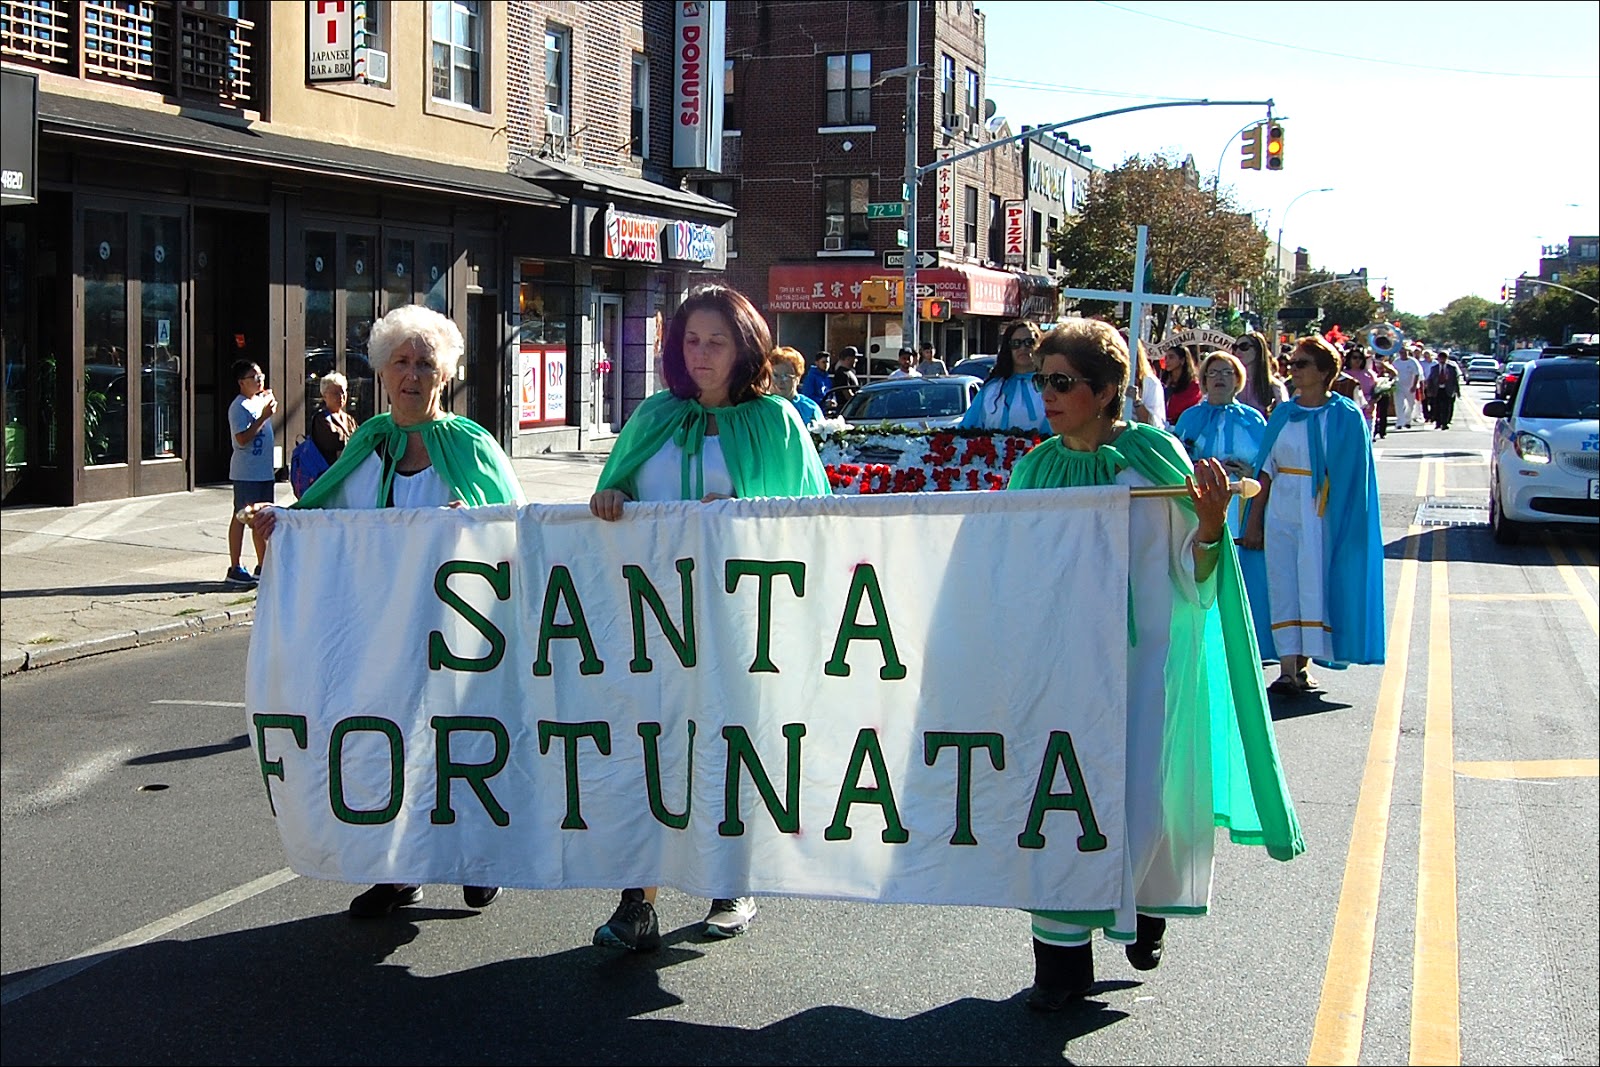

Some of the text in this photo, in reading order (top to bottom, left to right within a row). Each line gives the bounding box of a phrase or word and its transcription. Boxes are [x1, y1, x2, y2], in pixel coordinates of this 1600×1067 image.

[312, 50, 350, 62] JAPANESE
[311, 64, 327, 75] BAR
[334, 63, 351, 76] BBQ
[680, 26, 700, 126] DONUTS
[873, 204, 897, 216] 72 ST
[1007, 208, 1023, 253] PIZZA
[620, 240, 656, 260] DONUTS
[160, 322, 168, 339] A
[548, 361, 563, 387] BR
[428, 557, 907, 681] SANTA
[252, 712, 1107, 852] FORTUNATA
